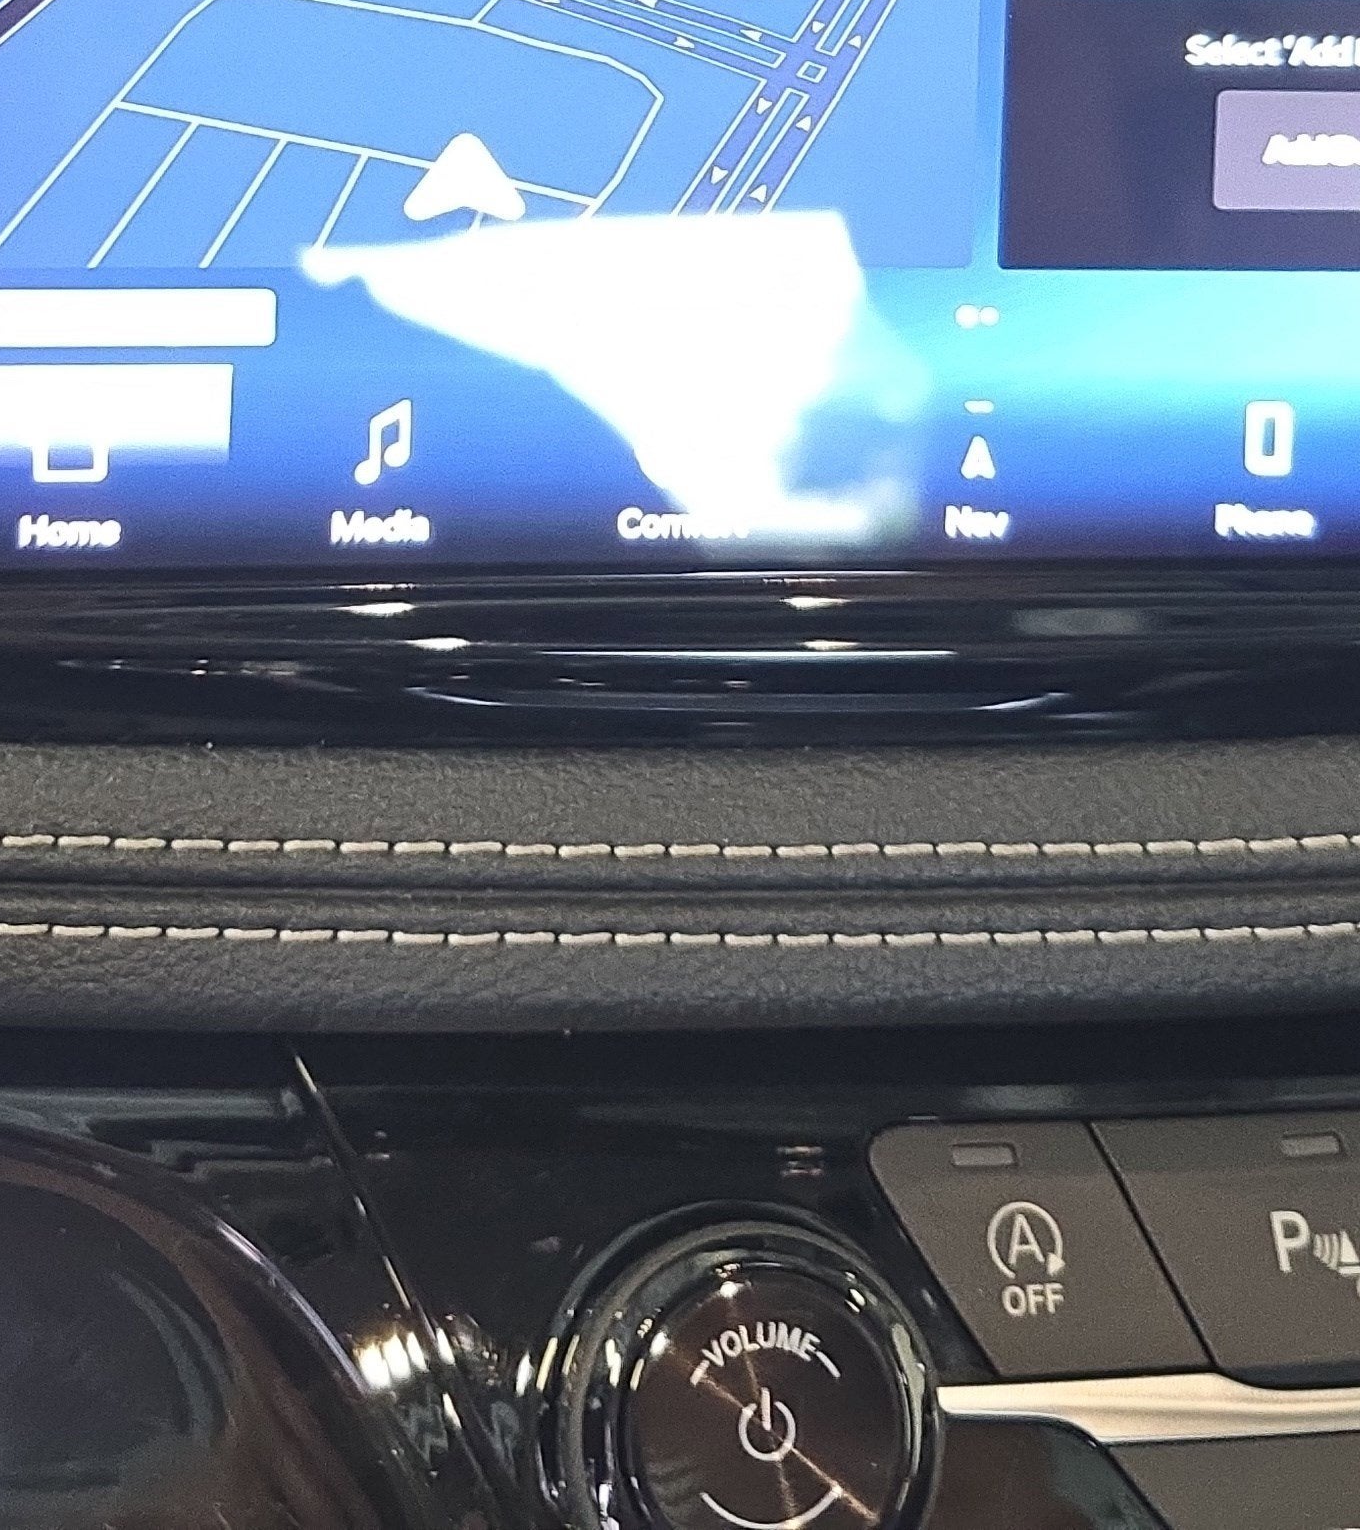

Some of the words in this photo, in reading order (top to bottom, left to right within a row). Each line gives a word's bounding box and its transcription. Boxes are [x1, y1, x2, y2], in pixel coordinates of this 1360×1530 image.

[1185, 33, 1285, 66] Select
[17, 514, 122, 549] Home
[330, 508, 432, 546] Media
[1001, 1281, 1065, 1317] OFF
[702, 1319, 823, 1370] VOLUME
